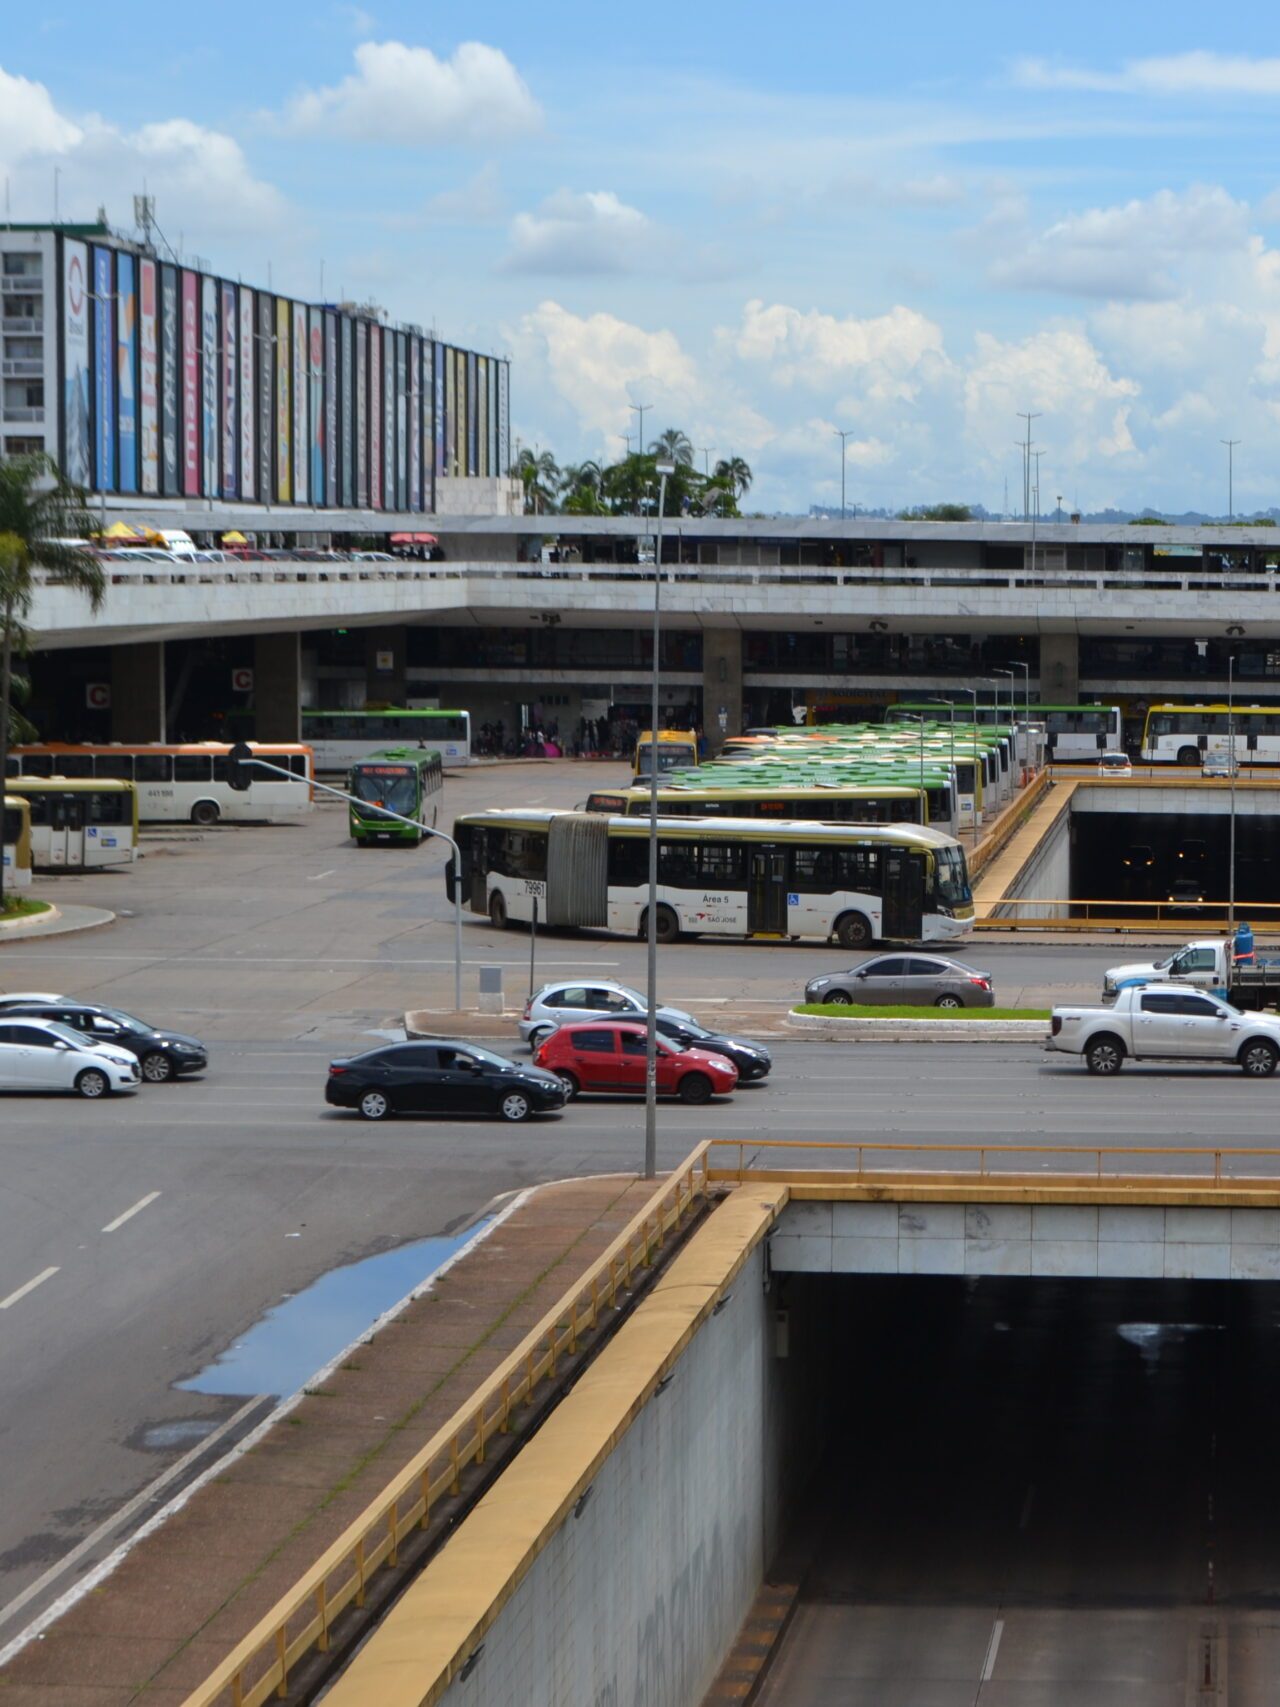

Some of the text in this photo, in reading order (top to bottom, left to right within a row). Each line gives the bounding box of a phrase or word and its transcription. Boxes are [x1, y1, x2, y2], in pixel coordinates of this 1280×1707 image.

[184, 298, 198, 471] marisa
[261, 307, 271, 490] RIACHUELO
[235, 671, 252, 690] C
[89, 686, 108, 706] C
[524, 880, 545, 896] 79961
[702, 894, 722, 903] Área
